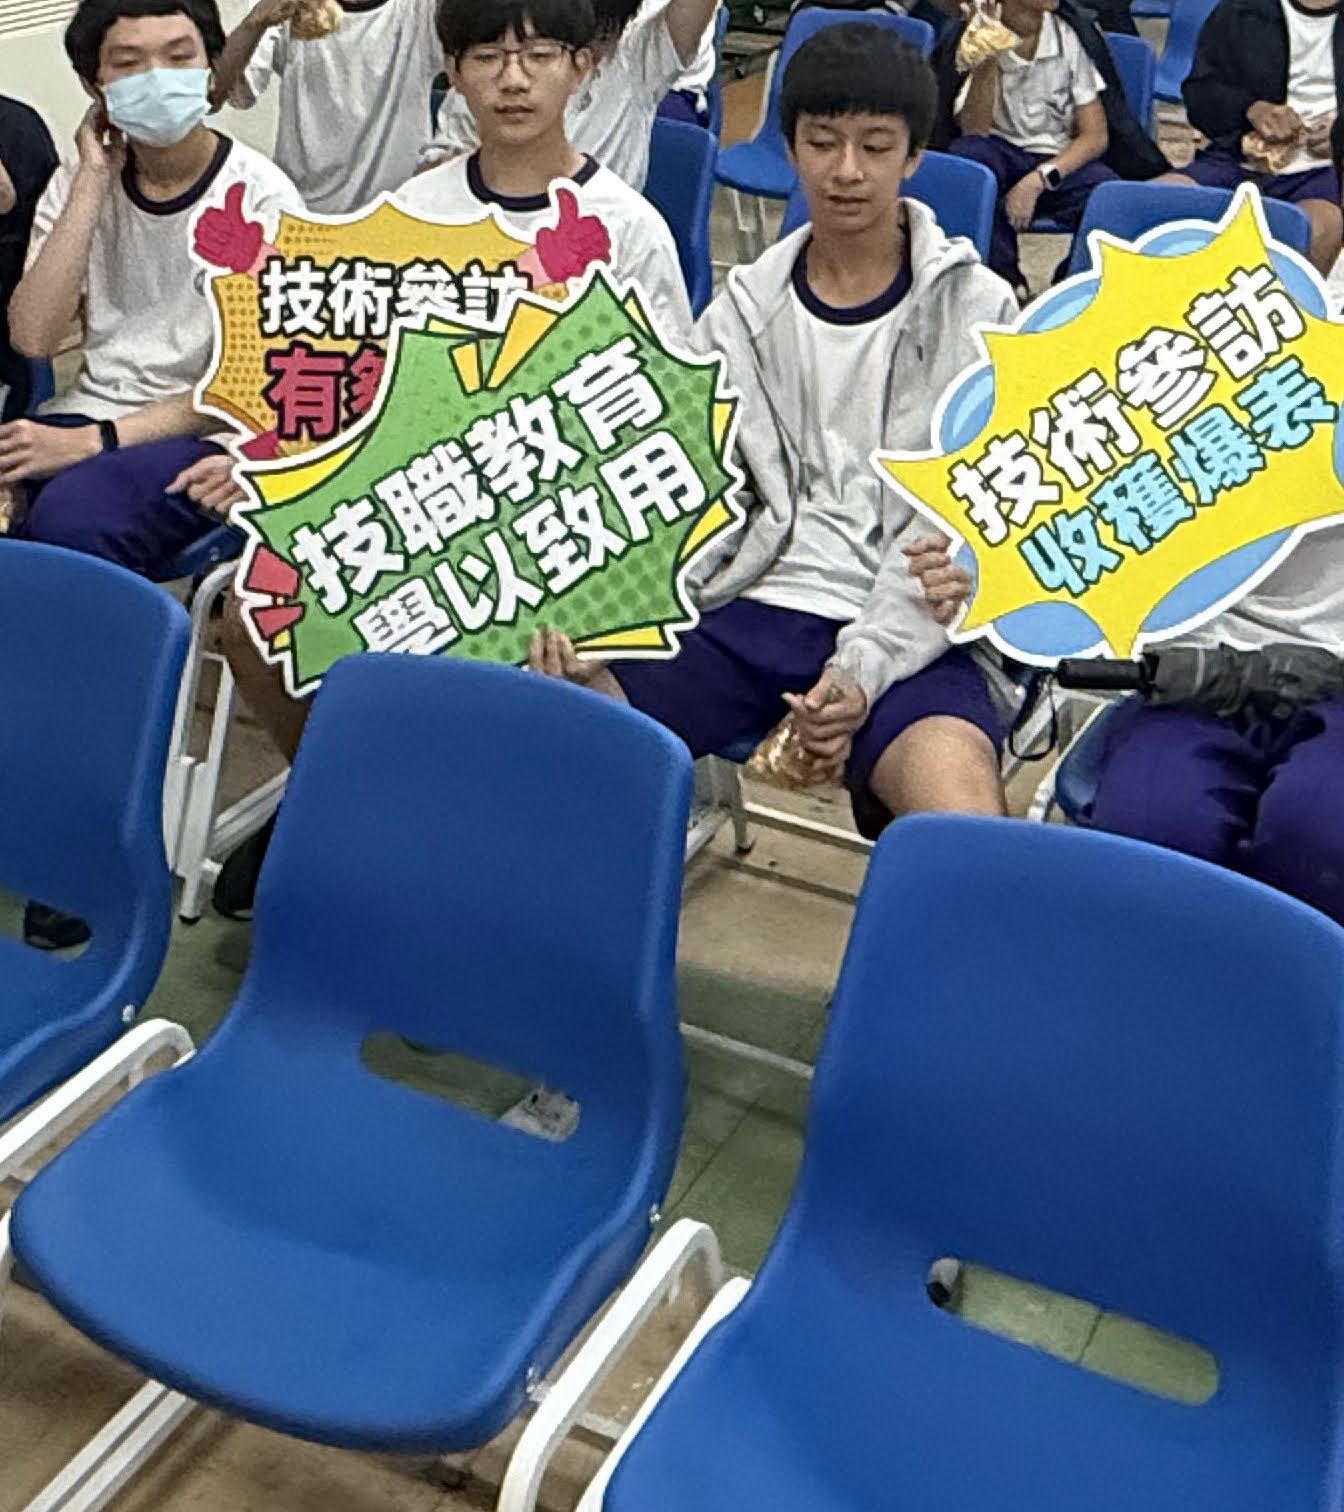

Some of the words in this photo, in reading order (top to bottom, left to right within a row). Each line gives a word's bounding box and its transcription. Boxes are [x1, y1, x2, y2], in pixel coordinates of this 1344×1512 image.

[291, 334, 667, 615] 技職教育
[948, 264, 1307, 546] 技術參訪
[1019, 357, 1338, 596] 收穫爆表
[351, 429, 709, 655] 學以致用
